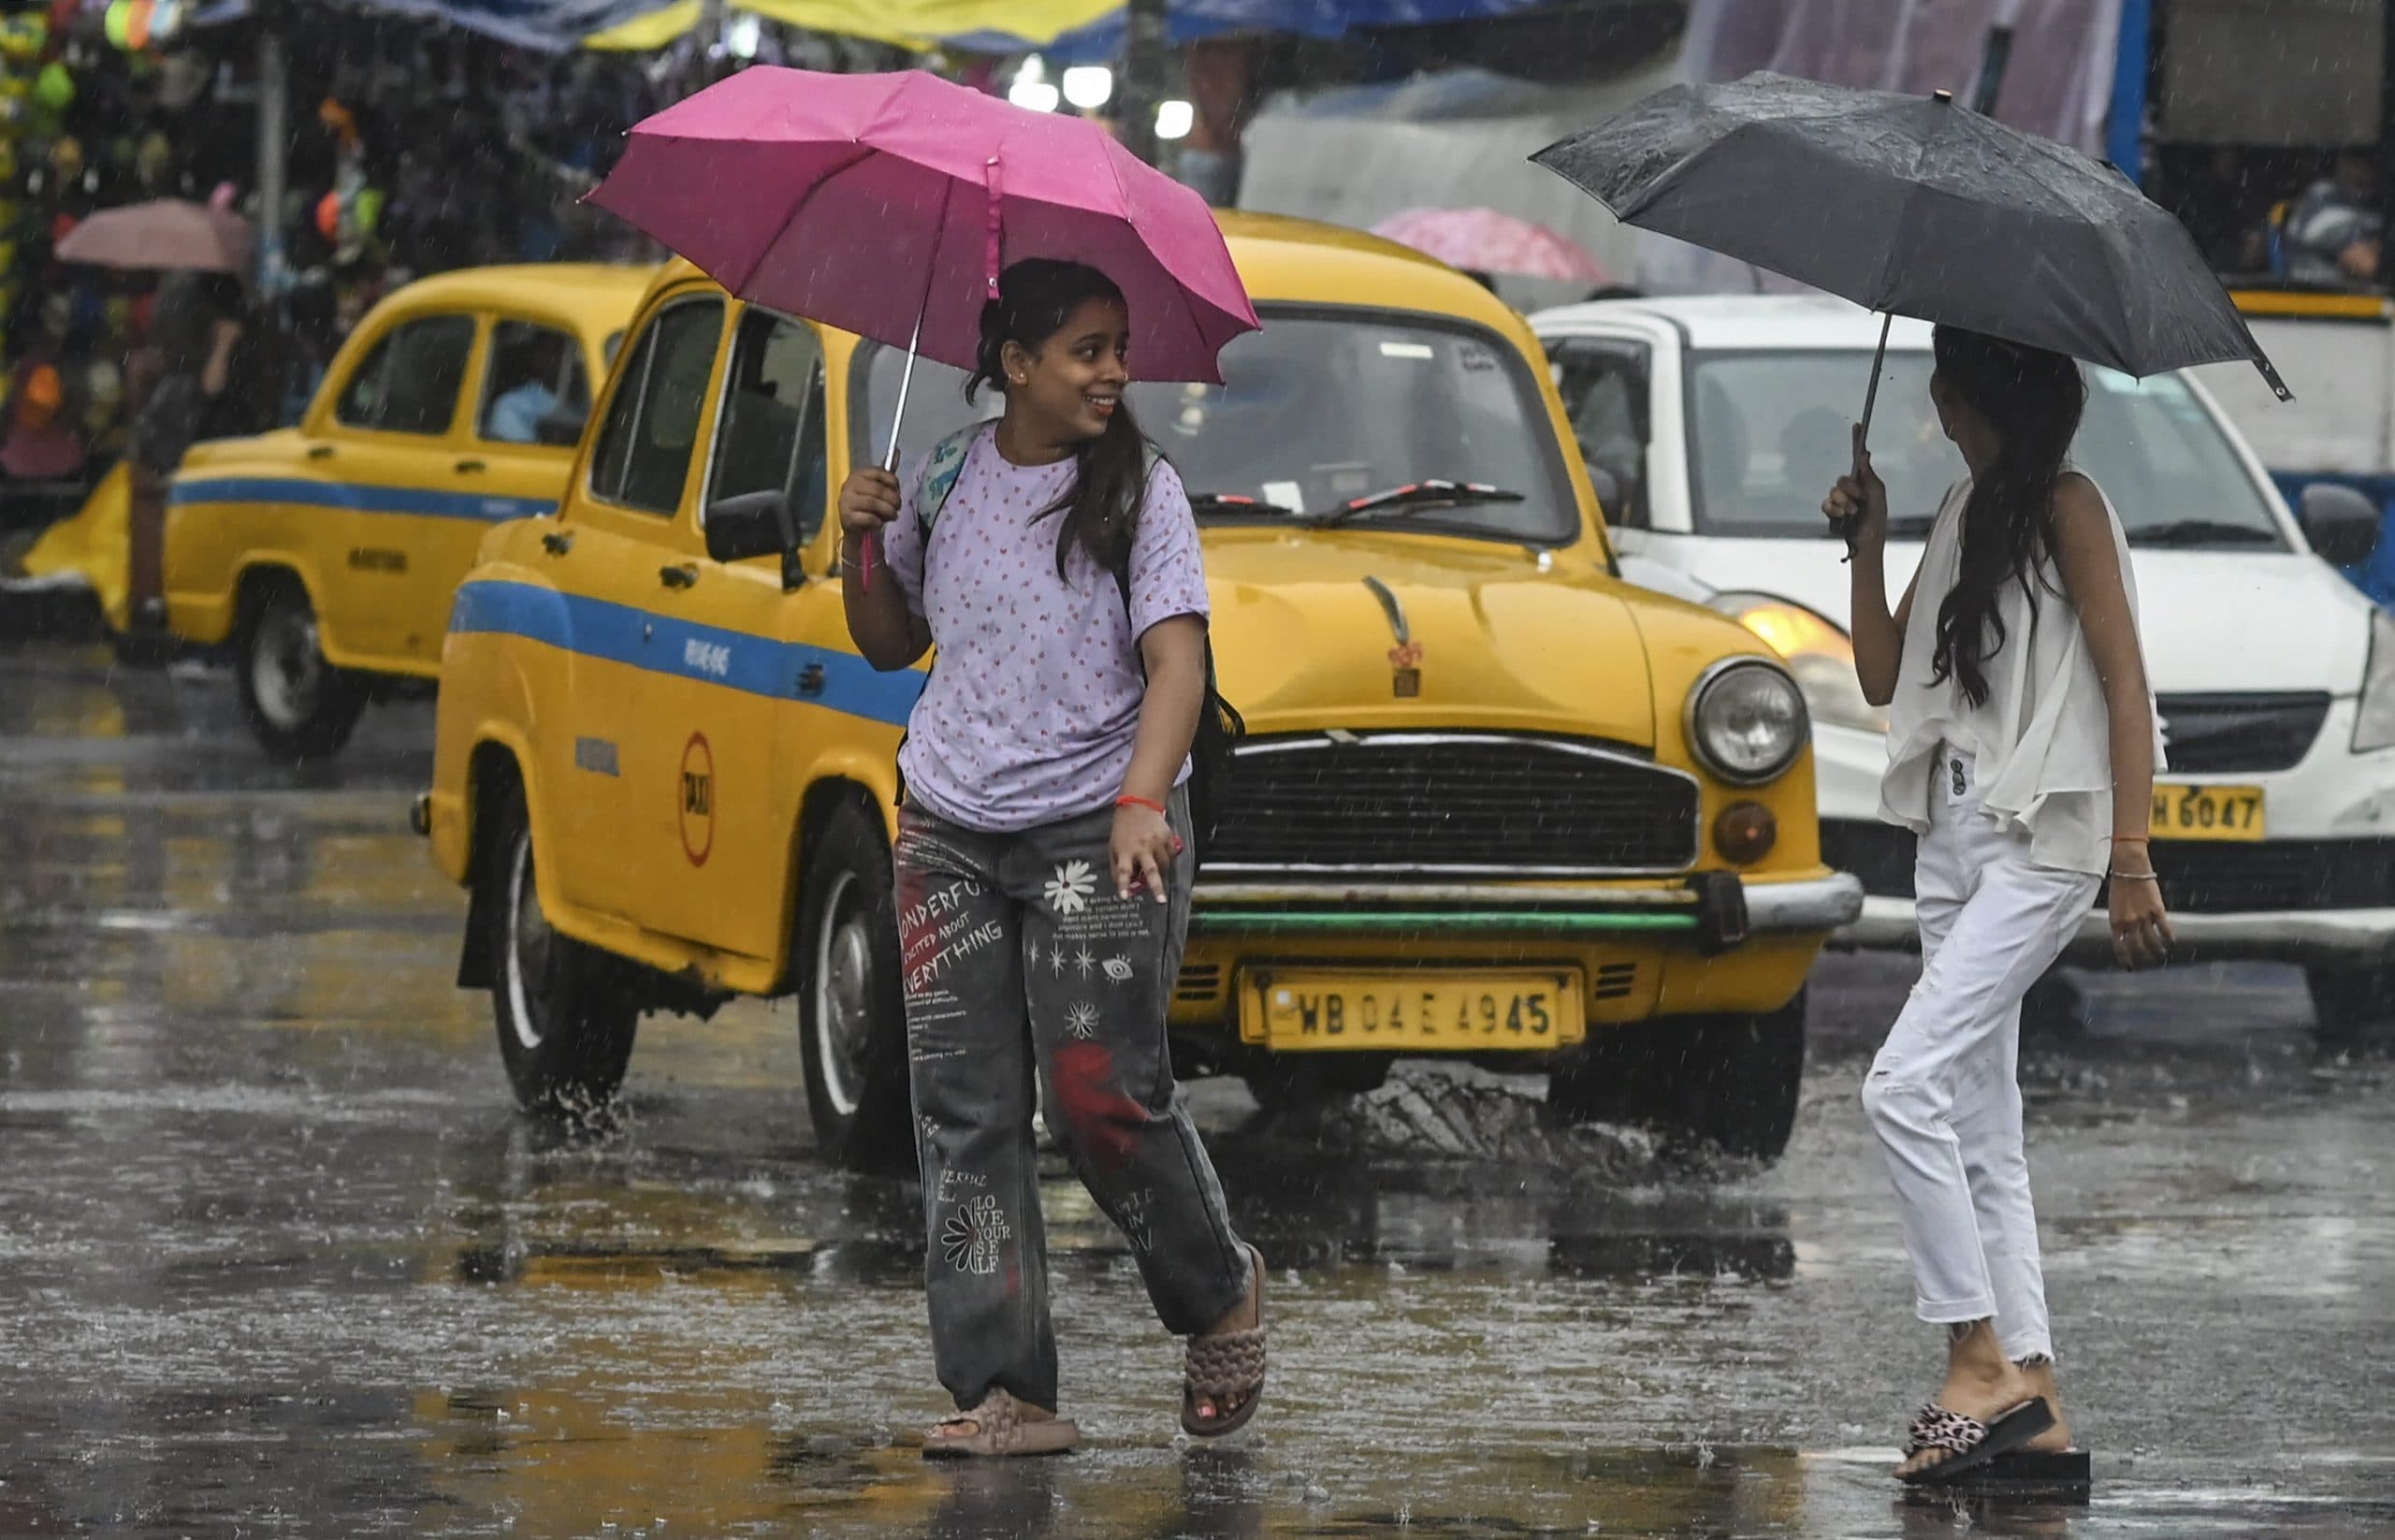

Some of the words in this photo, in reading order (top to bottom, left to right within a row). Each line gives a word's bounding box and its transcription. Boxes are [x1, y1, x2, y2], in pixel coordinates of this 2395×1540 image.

[2178, 796, 2260, 830] 6047
[899, 879, 989, 951] ONDERFU
[937, 910, 970, 940] ABOUT
[1299, 994, 1343, 1035] WB
[1459, 993, 1549, 1035] 4945
[977, 1195, 995, 1210] LO
[976, 1210, 1004, 1228] VE
[977, 1226, 1011, 1241] YOUR
[976, 1240, 999, 1256] SE
[978, 1256, 999, 1274] LF
